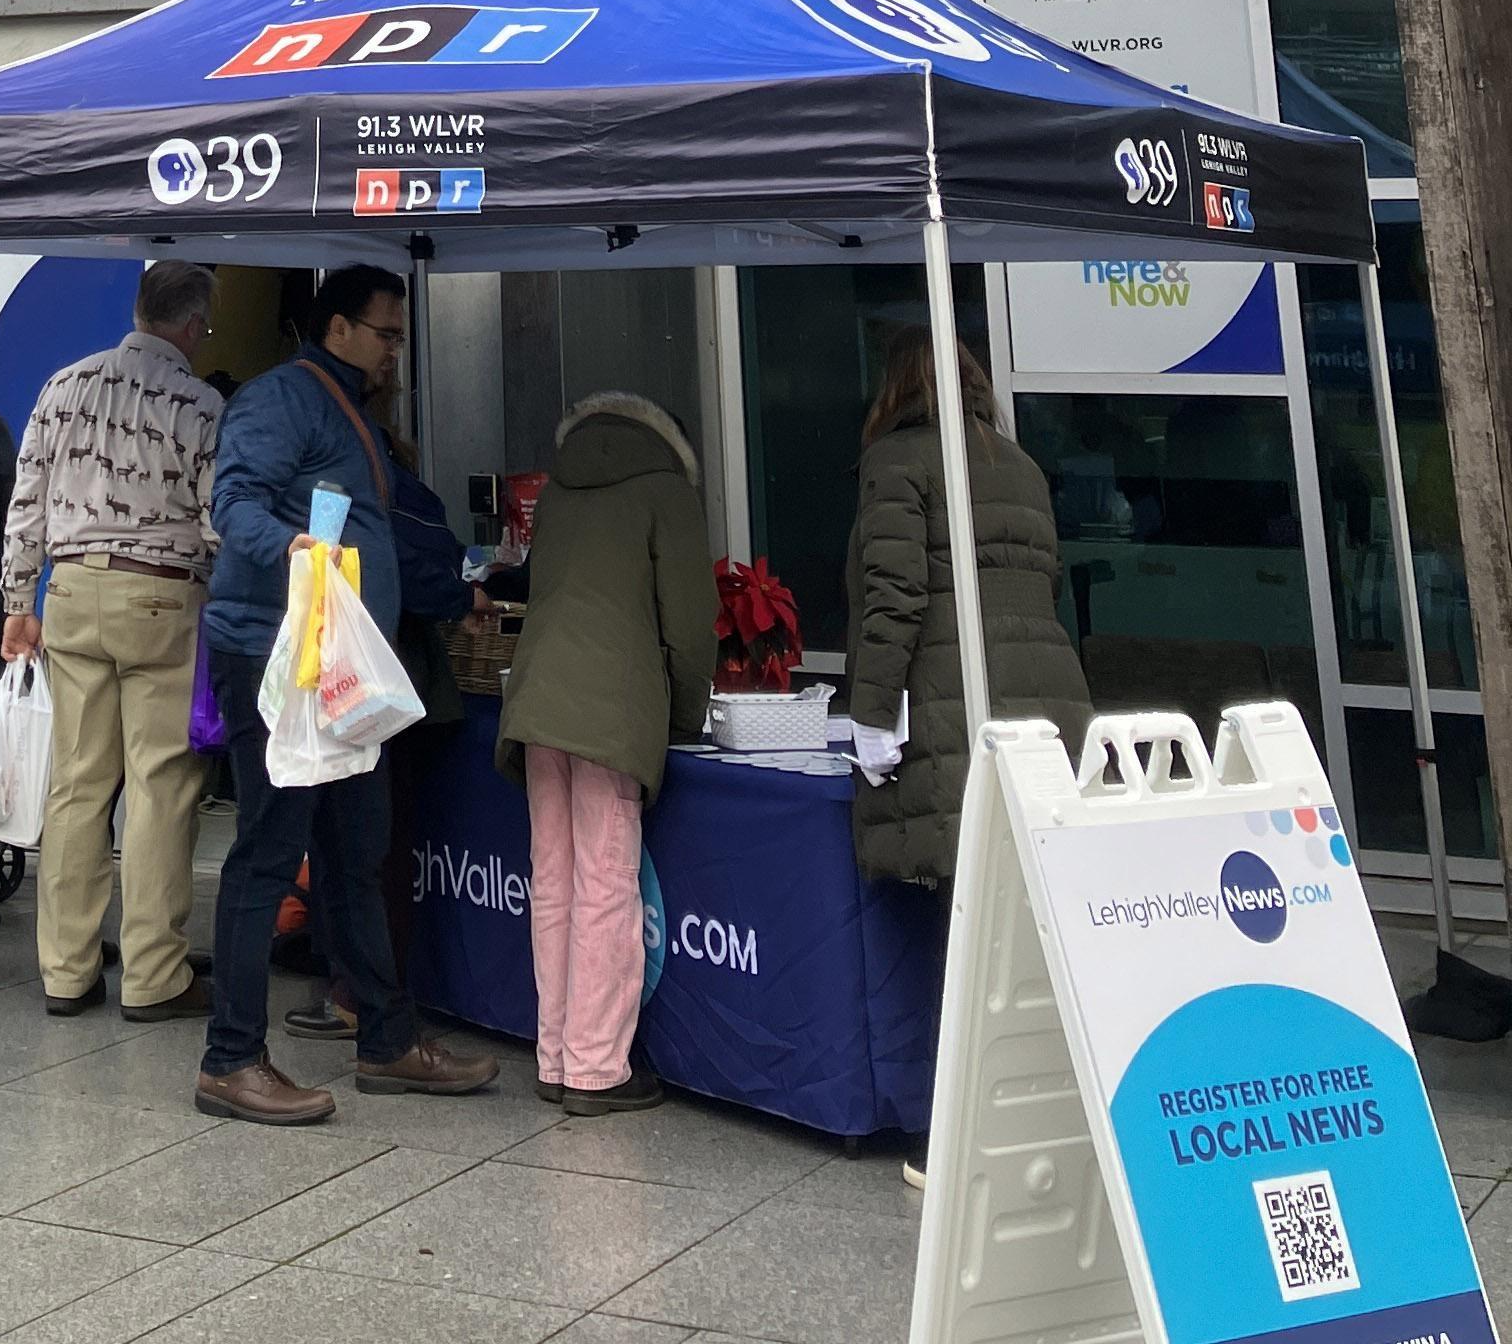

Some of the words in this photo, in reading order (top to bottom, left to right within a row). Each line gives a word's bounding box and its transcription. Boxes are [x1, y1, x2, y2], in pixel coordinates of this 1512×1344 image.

[252, 20, 548, 66] npr
[1071, 37, 1163, 53] WLVR.ORG
[357, 115, 401, 138] 91.3
[409, 115, 485, 138] WLVR
[358, 143, 416, 155] LEHIGH
[424, 142, 485, 155] VALLEY
[1217, 138, 1248, 162] WLVR
[205, 133, 283, 203] 39
[1139, 138, 1179, 207] 39
[366, 177, 471, 211] npr
[1208, 193, 1247, 226] npr
[1109, 277, 1190, 307] Now
[1158, 1079, 1270, 1119] REGISTER
[1270, 1072, 1318, 1102] FOR
[1317, 1064, 1374, 1095] FREE
[1168, 1116, 1287, 1166] LOCAL
[1287, 1099, 1385, 1148] NEWS
